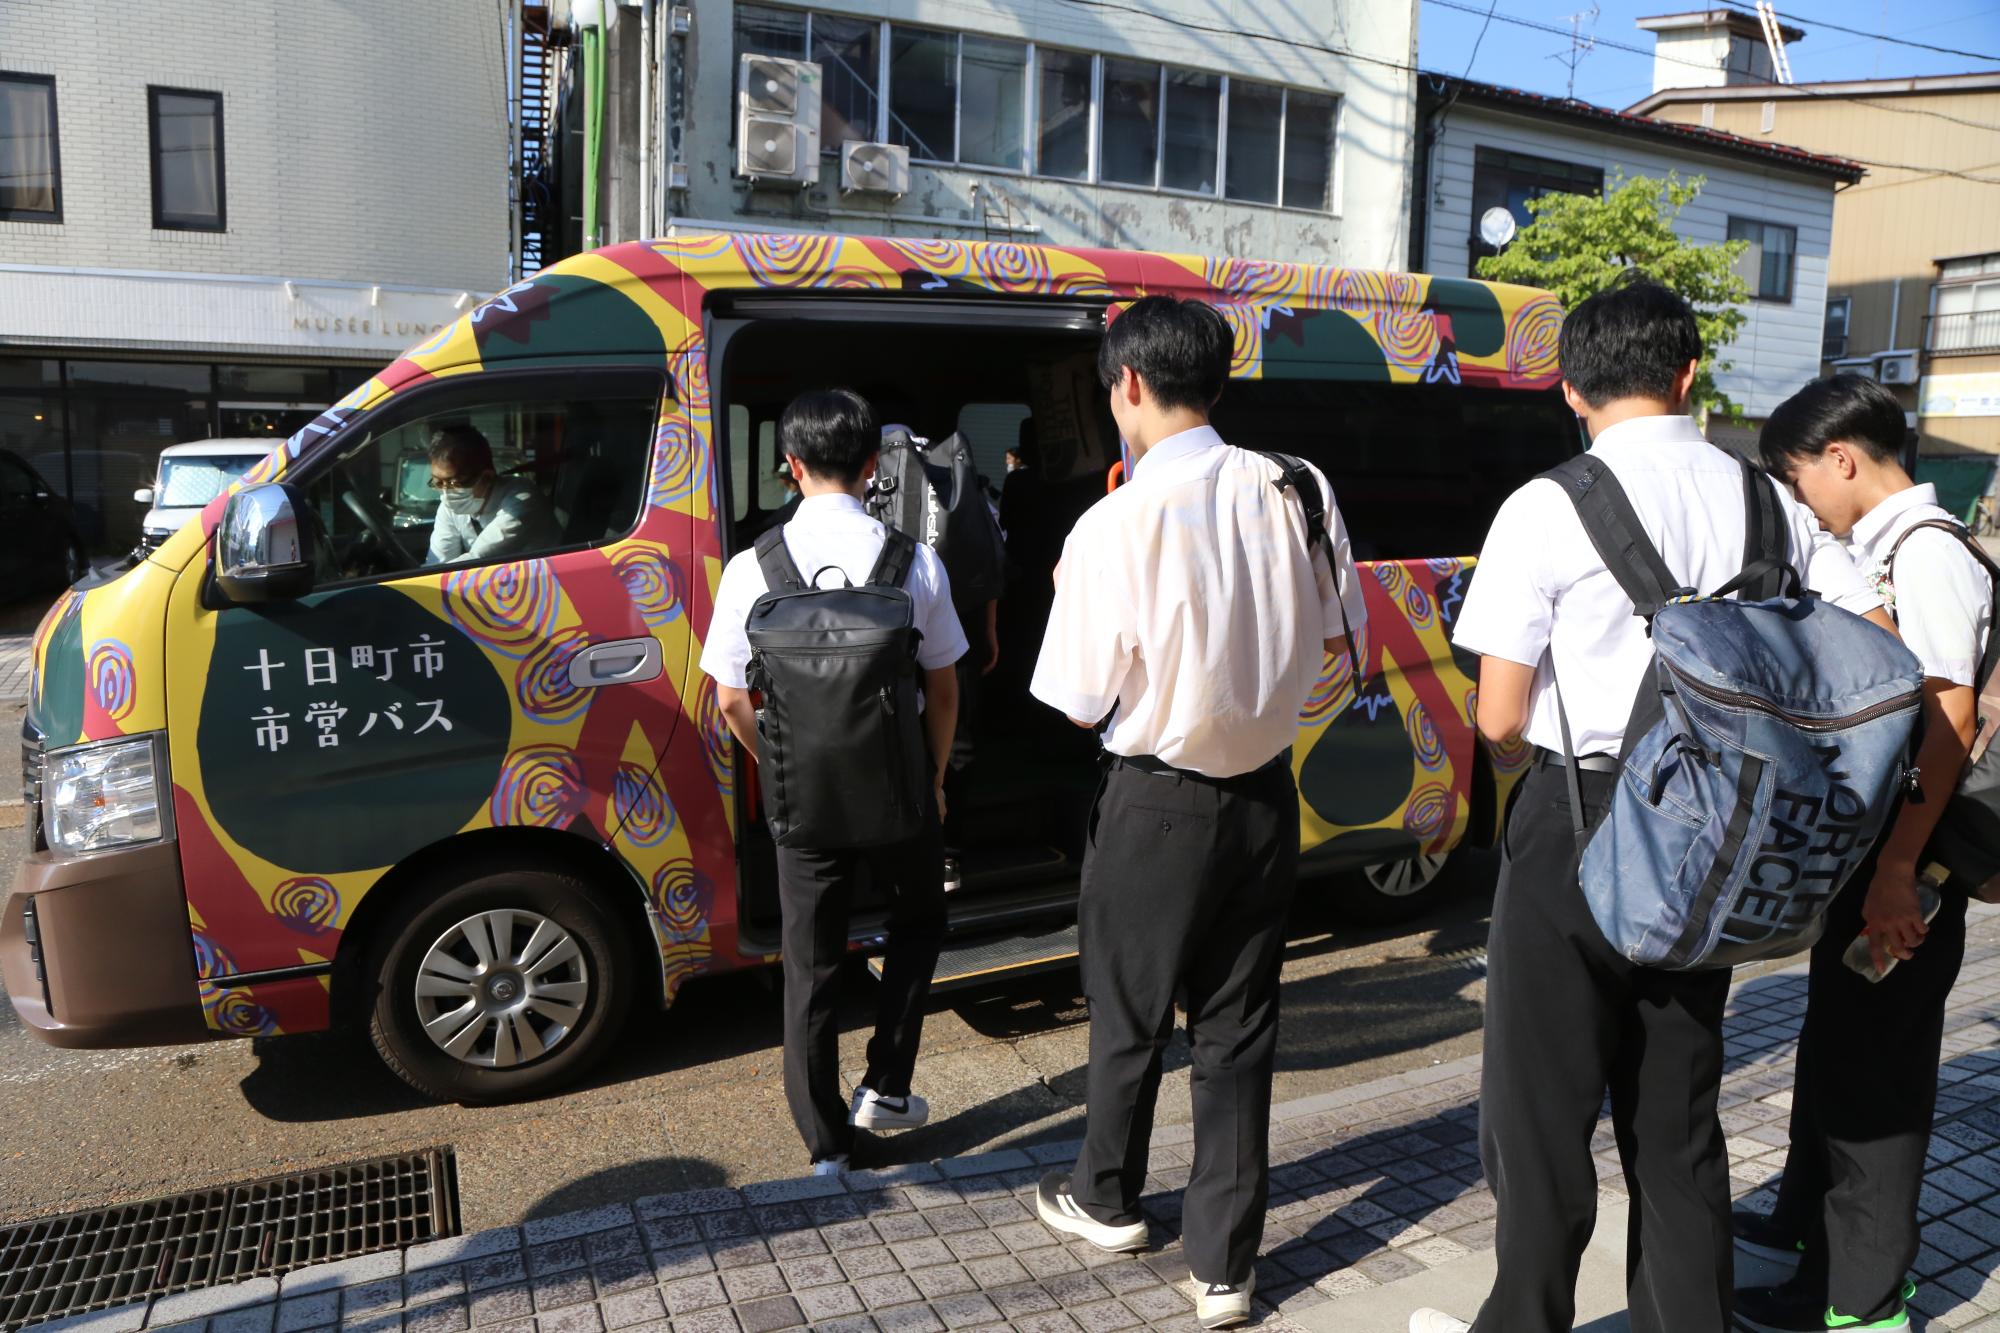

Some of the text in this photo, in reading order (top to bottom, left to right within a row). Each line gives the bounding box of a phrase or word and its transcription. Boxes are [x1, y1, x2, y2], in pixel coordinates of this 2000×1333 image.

[293, 316, 370, 334] MUSÉE
[243, 633, 446, 691] 十日町市
[250, 699, 453, 751] 市営バス
[1732, 789, 1824, 923] FACE
